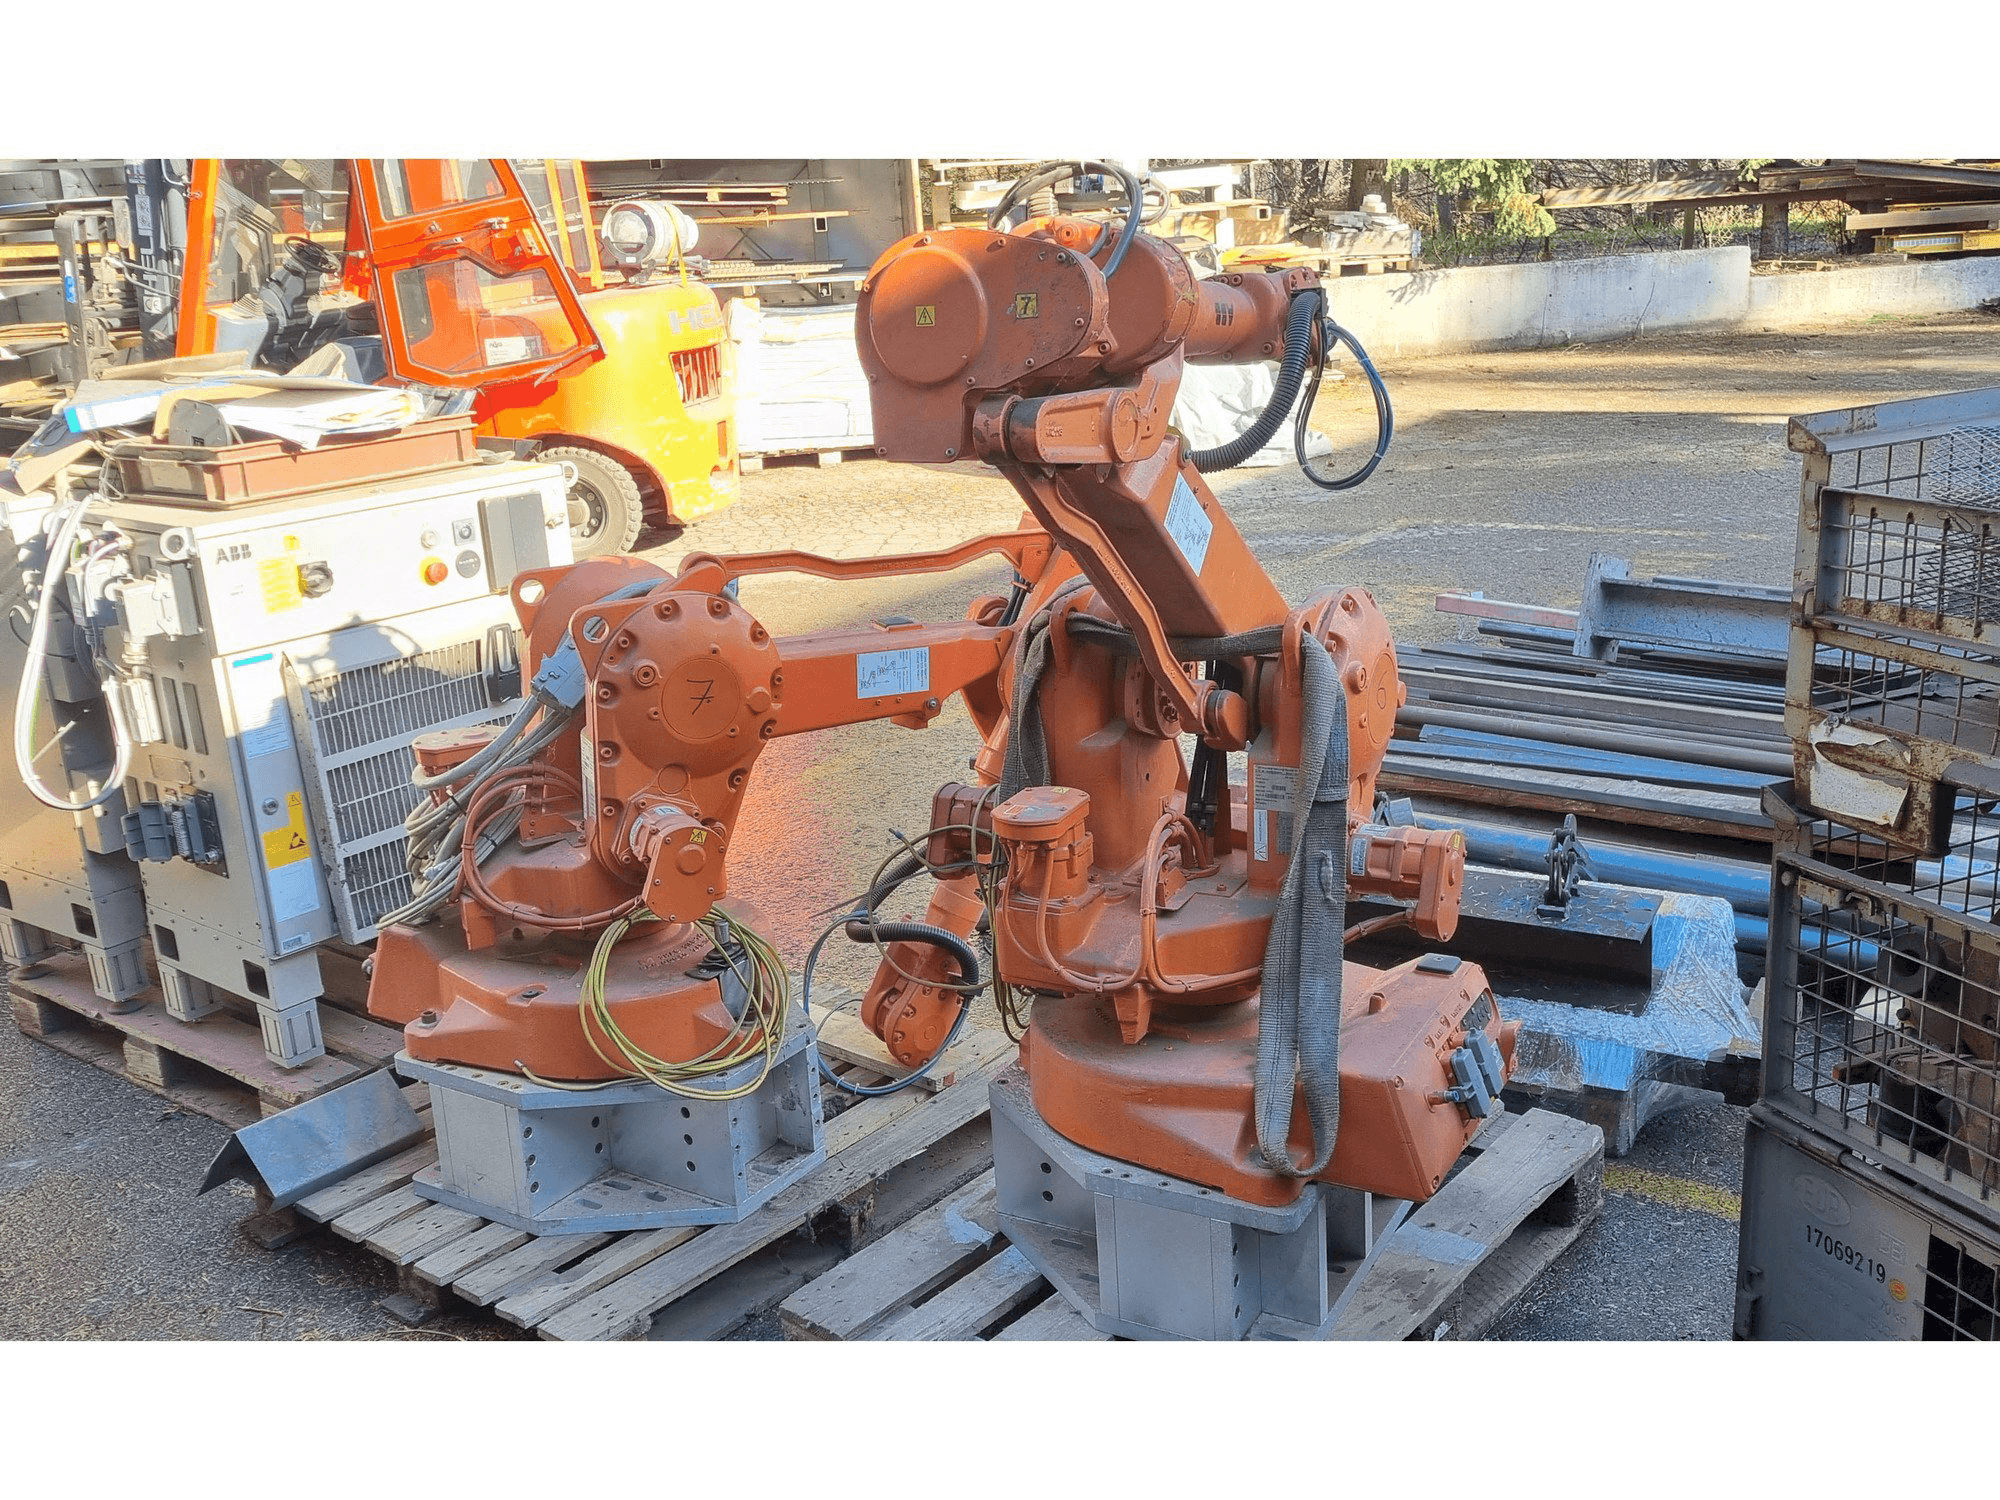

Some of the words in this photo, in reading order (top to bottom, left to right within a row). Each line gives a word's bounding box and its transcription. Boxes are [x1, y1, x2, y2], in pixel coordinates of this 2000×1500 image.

[1020, 296, 1032, 315] 7
[215, 543, 252, 565] ABB
[686, 678, 715, 716] 7
[1805, 1224, 1886, 1284] 17069219
